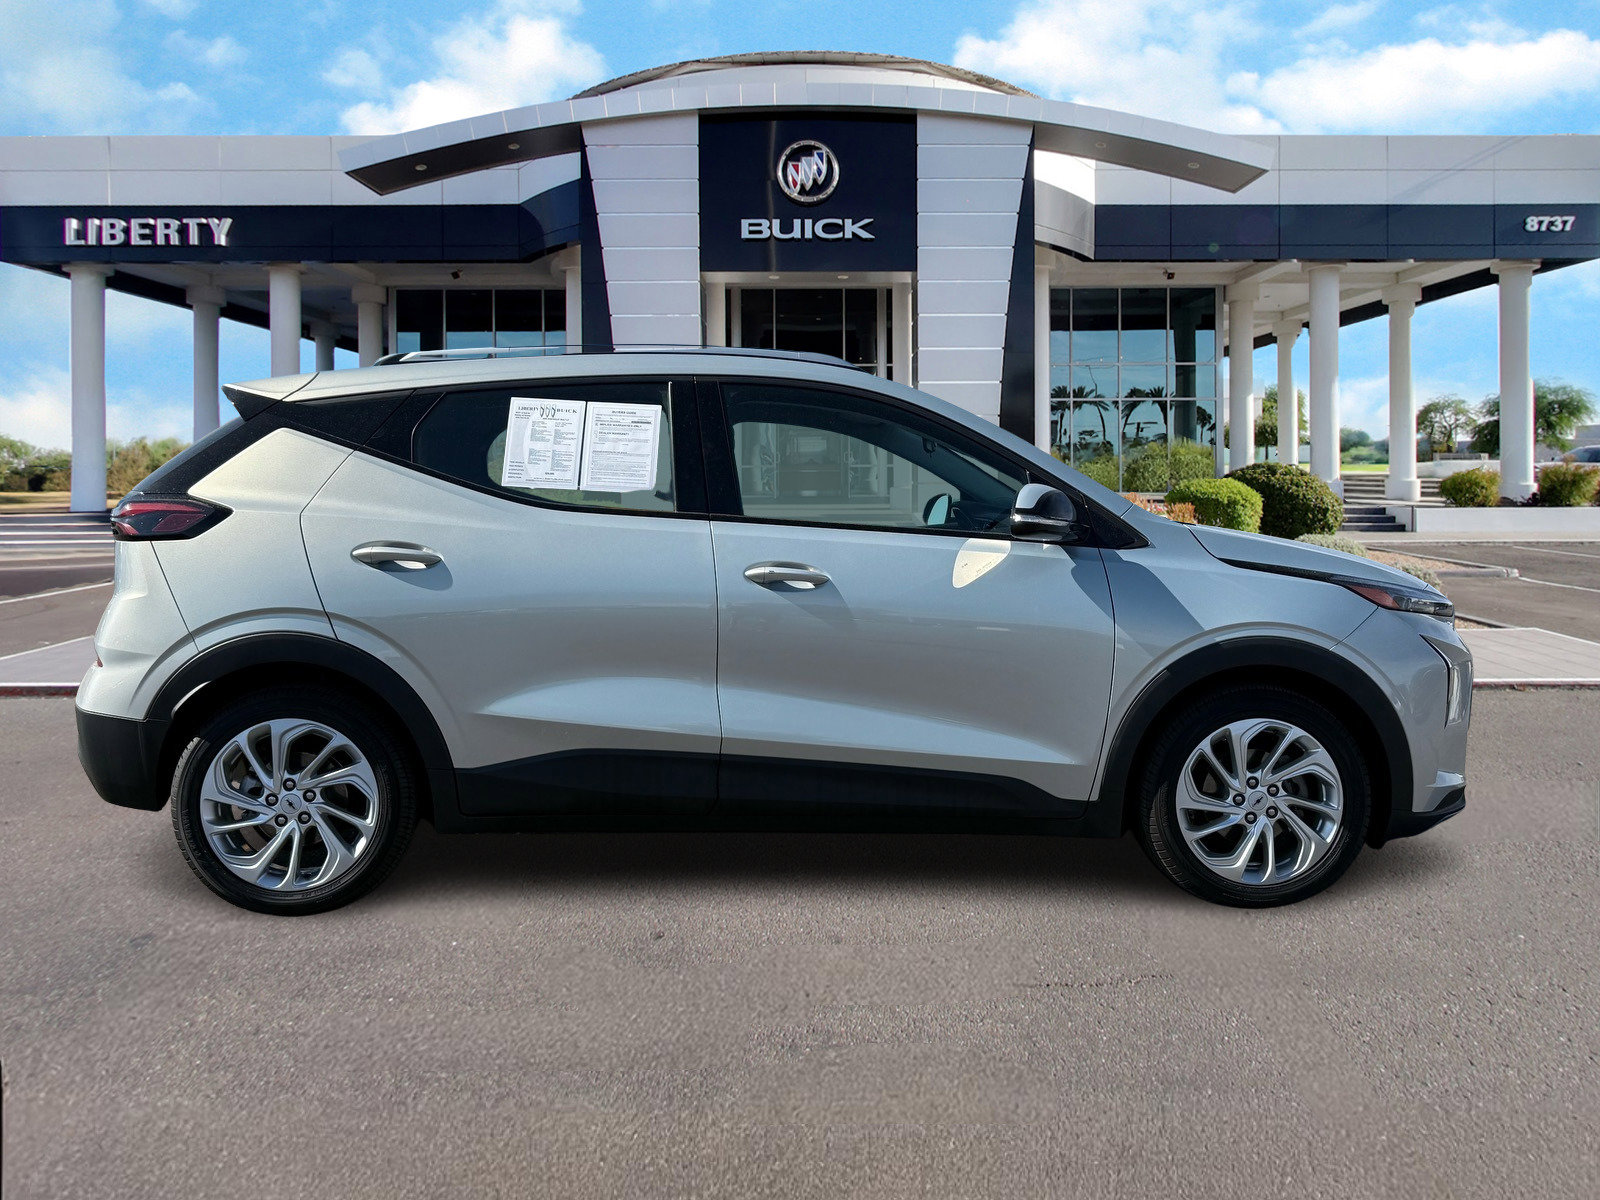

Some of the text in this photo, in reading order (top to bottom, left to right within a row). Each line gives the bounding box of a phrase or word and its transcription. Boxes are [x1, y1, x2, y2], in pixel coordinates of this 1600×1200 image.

[64, 218, 234, 247] LIBERTY
[741, 218, 876, 240] BUICK
[1525, 216, 1576, 231] 8737
